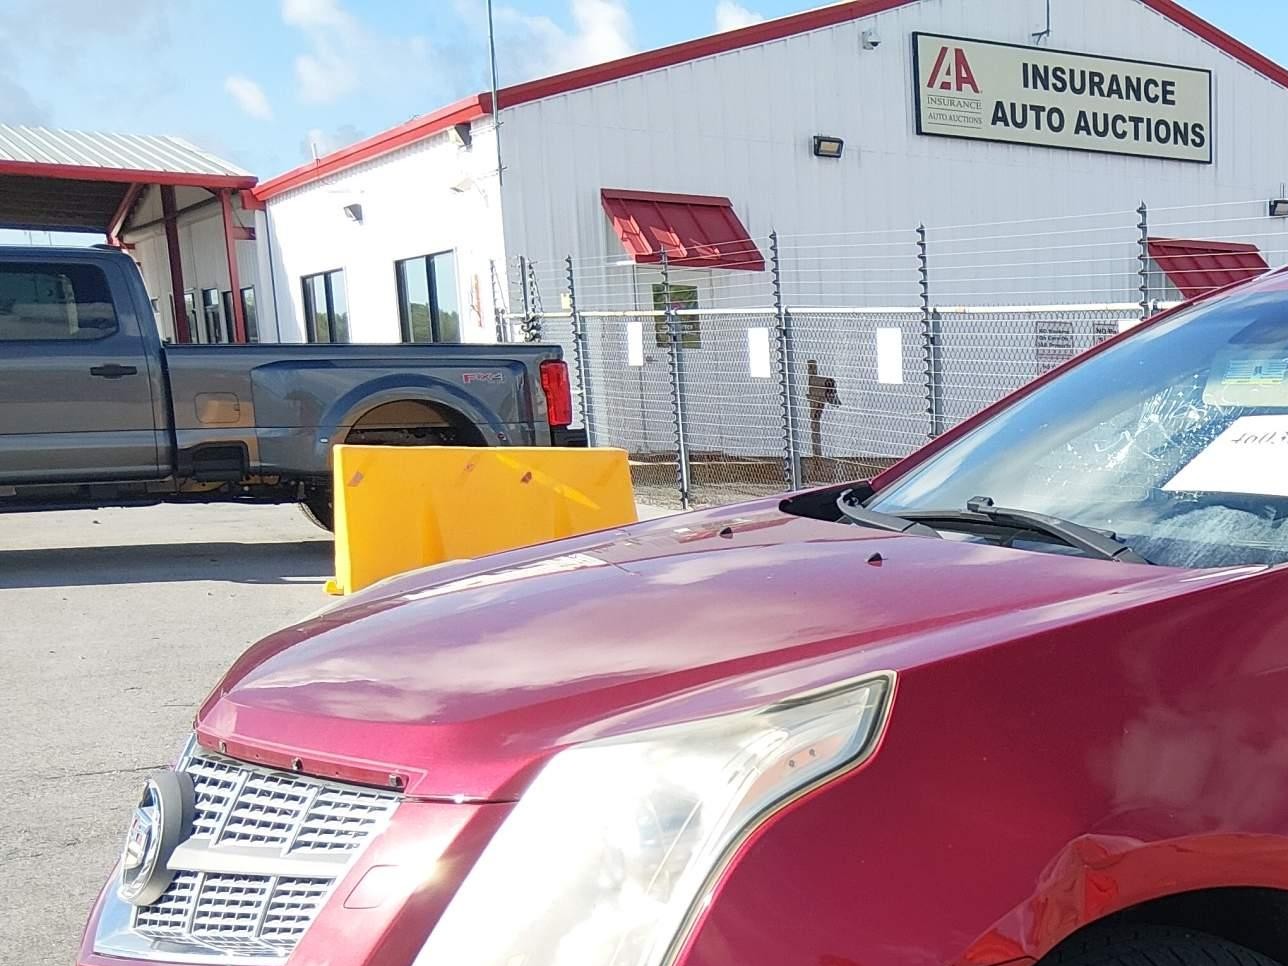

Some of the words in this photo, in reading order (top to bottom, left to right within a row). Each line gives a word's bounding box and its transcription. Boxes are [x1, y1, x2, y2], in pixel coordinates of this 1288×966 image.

[1022, 62, 1176, 106] INSURANCE
[928, 96, 983, 110] INSURANCE
[928, 111, 948, 121] AUTO
[951, 114, 983, 125] AUCTIONS
[990, 100, 1066, 133] AUTO
[1073, 110, 1206, 148] AUCTIONS
[463, 371, 504, 384] FX4
